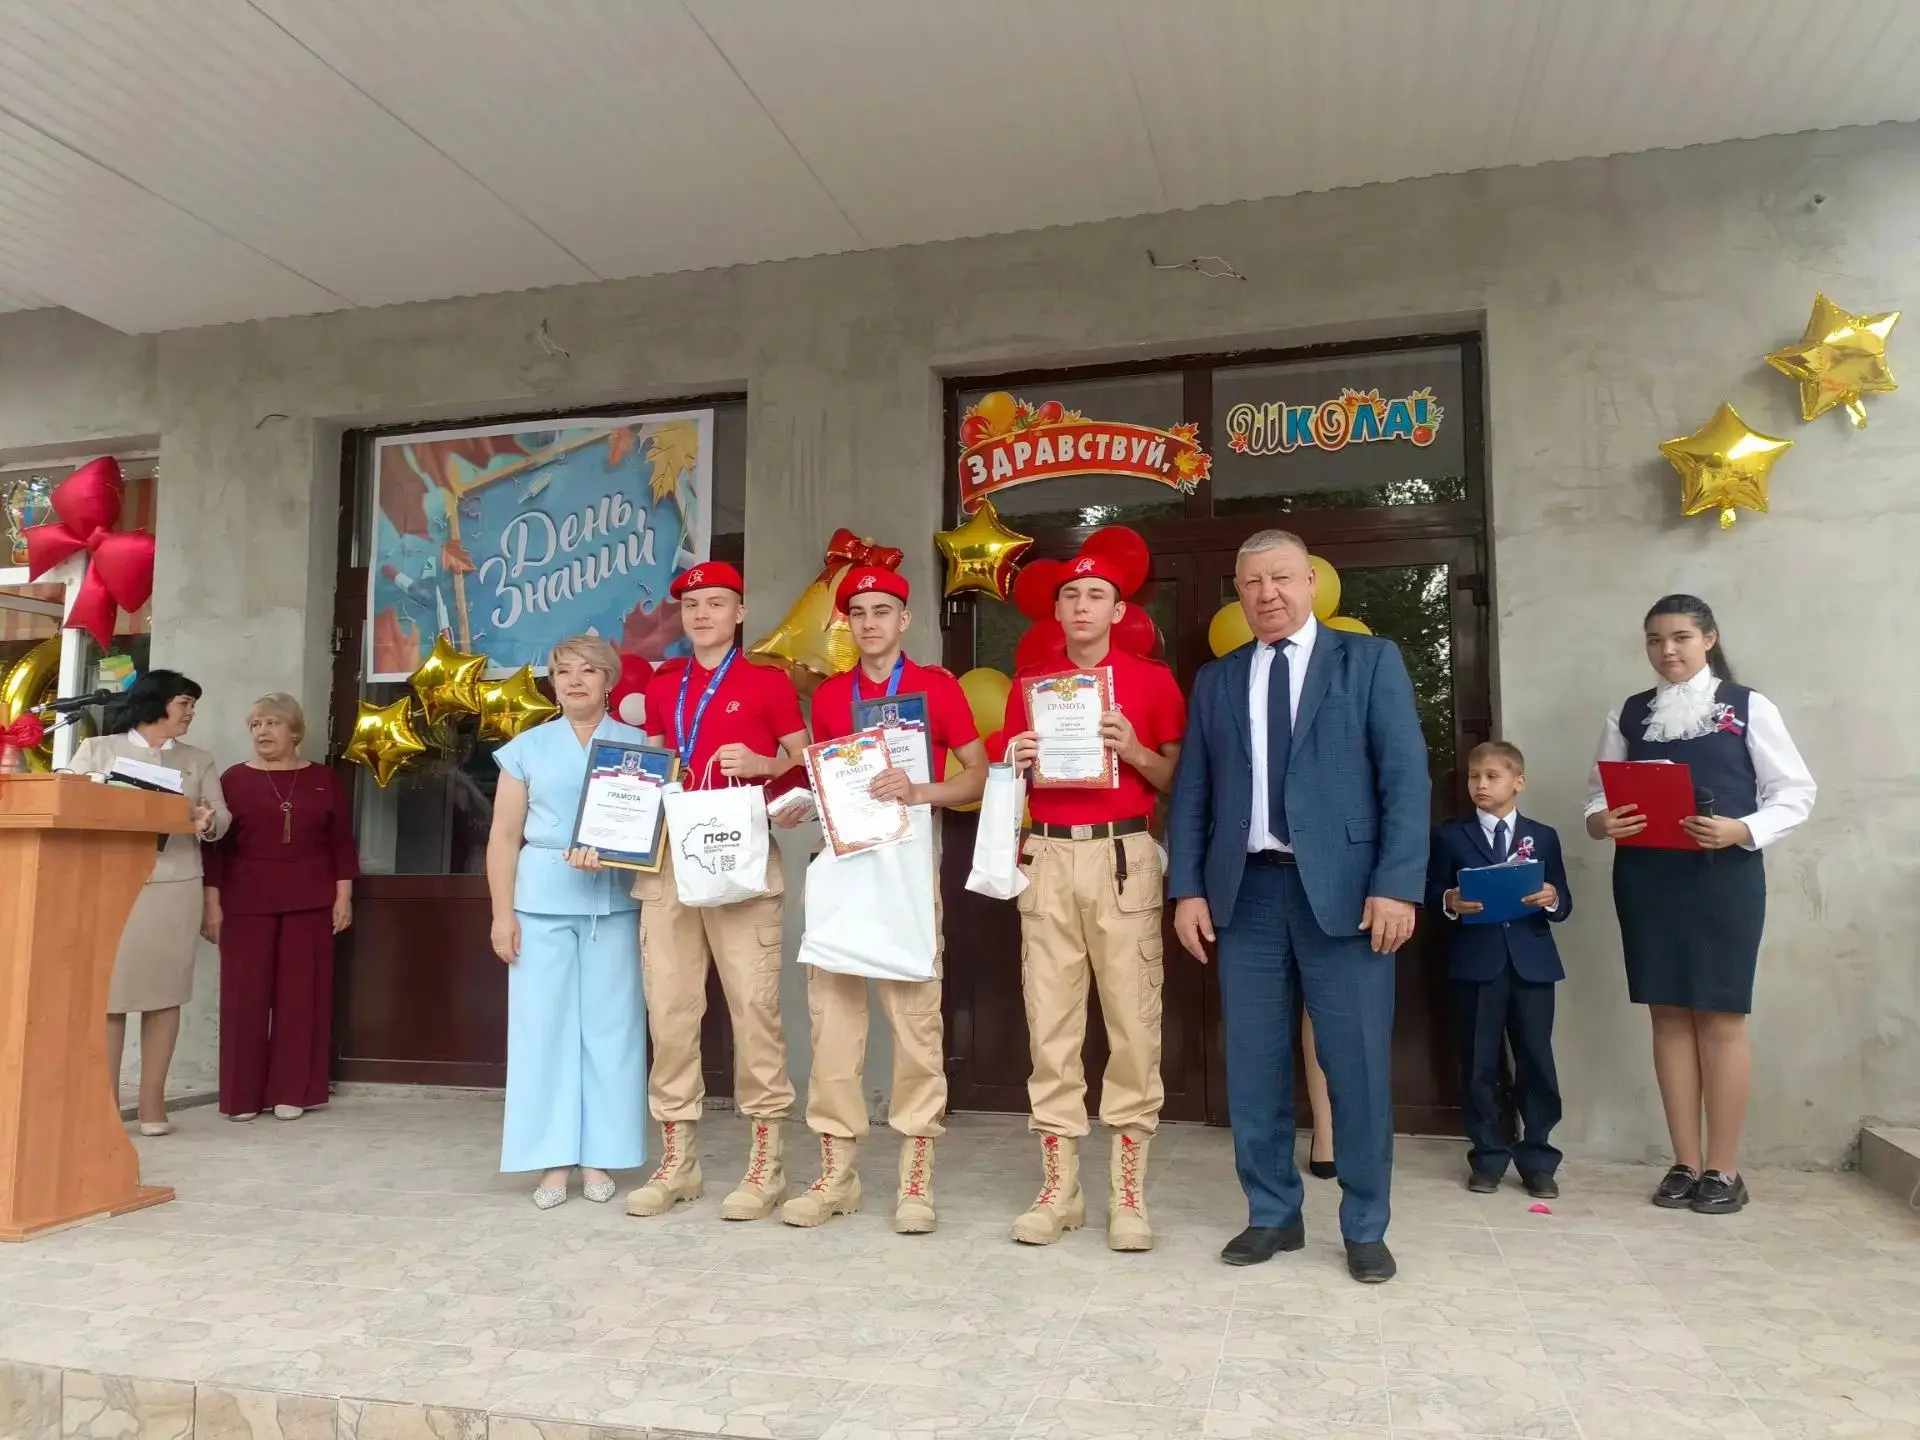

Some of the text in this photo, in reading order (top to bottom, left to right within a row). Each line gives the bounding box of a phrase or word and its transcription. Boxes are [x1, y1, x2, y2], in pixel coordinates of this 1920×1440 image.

[1228, 398, 1434, 454] ШКОЛА!
[967, 433, 1171, 485] ЗДРАВСТВУЙ,
[500, 492, 632, 578] День
[479, 508, 656, 629] Знаний
[1047, 702, 1086, 711] ГРАМОТА
[890, 745, 910, 754] МОТА
[835, 763, 874, 779] ГРАМОТА
[607, 791, 641, 802] ГРАМОТА
[704, 830, 742, 844] ПФО
